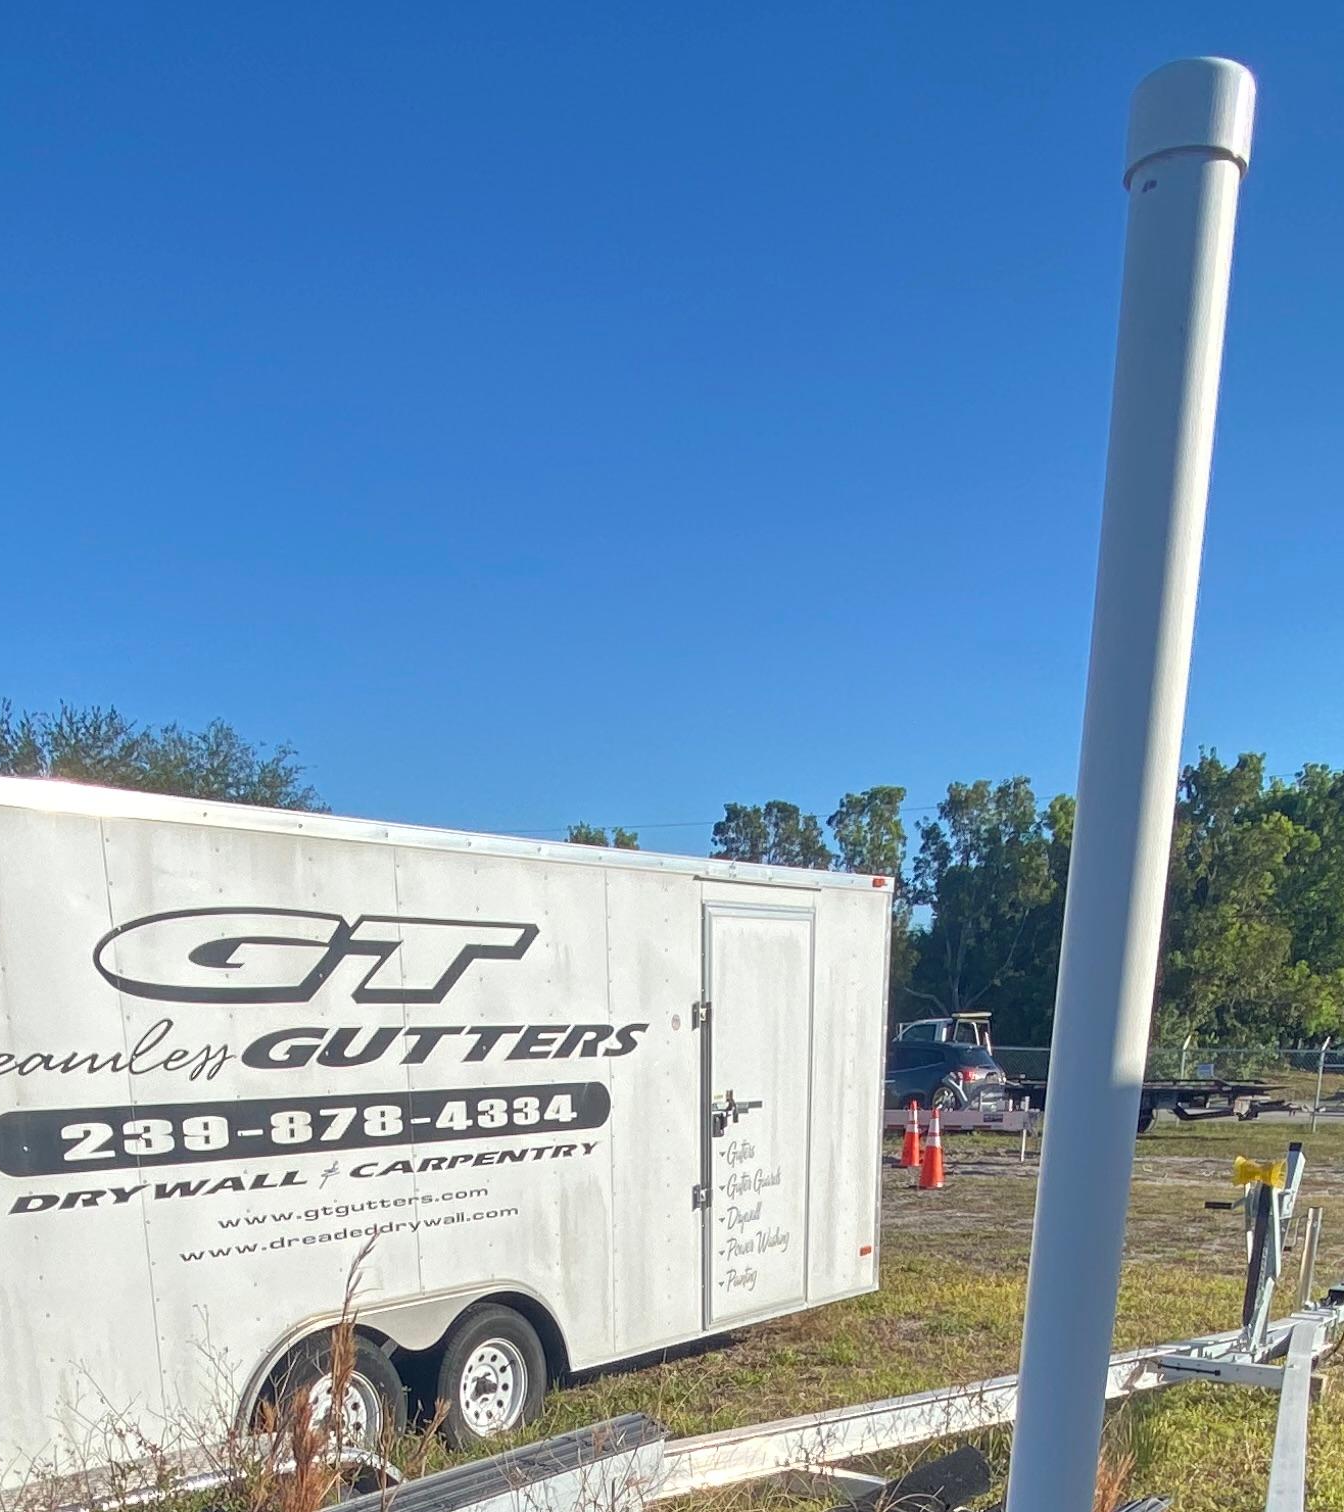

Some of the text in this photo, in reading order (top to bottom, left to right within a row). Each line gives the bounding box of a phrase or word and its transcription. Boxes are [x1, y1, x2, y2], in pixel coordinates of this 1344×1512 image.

[93, 906, 540, 1004] GT
[241, 1023, 650, 1070] GUTTERS
[59, 1093, 578, 1162] 239-878-4334
[7, 1169, 310, 1217] DRYWALL
[348, 1140, 601, 1180] CARPENTRY
[216, 1185, 490, 1230] www.gtgutters.com
[178, 1206, 520, 1264] www.dreadeddrywall.com
